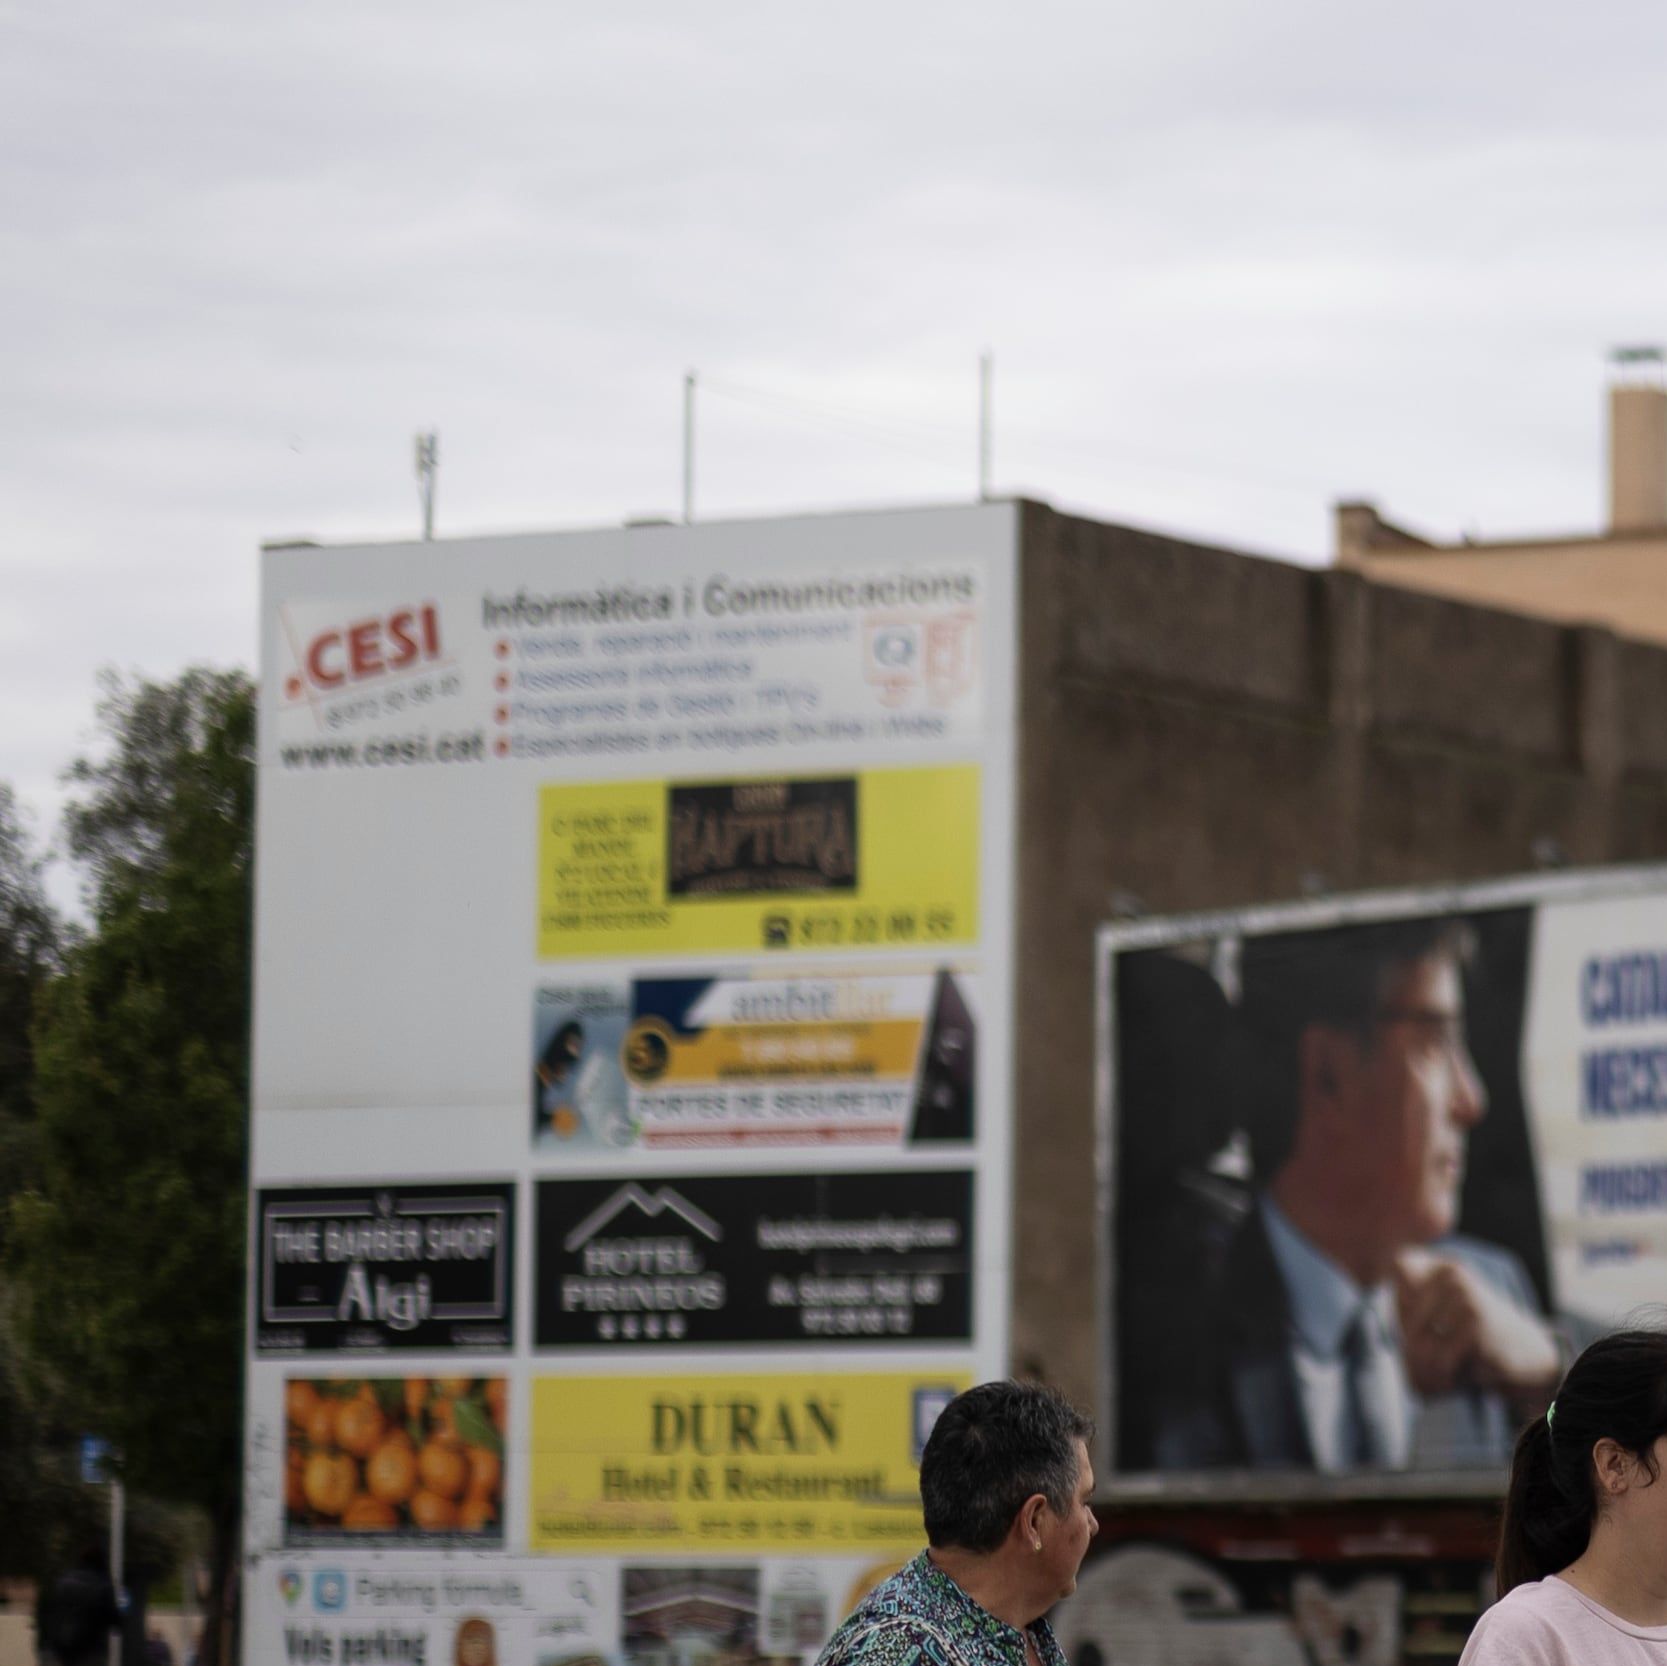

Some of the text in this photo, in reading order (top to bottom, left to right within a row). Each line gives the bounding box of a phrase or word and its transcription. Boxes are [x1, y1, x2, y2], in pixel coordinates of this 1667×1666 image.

[682, 574, 698, 617] i
[702, 570, 977, 618] Comunicacions
[282, 728, 486, 769] www.cesi.cat
[273, 1215, 497, 1263] THE BARBER SHOP
[583, 1237, 702, 1276] HOTEL
[560, 1273, 727, 1313] PIRINEOS
[650, 1393, 842, 1457] DURAN
[602, 1463, 679, 1501] Hotel
[688, 1462, 714, 1500] &
